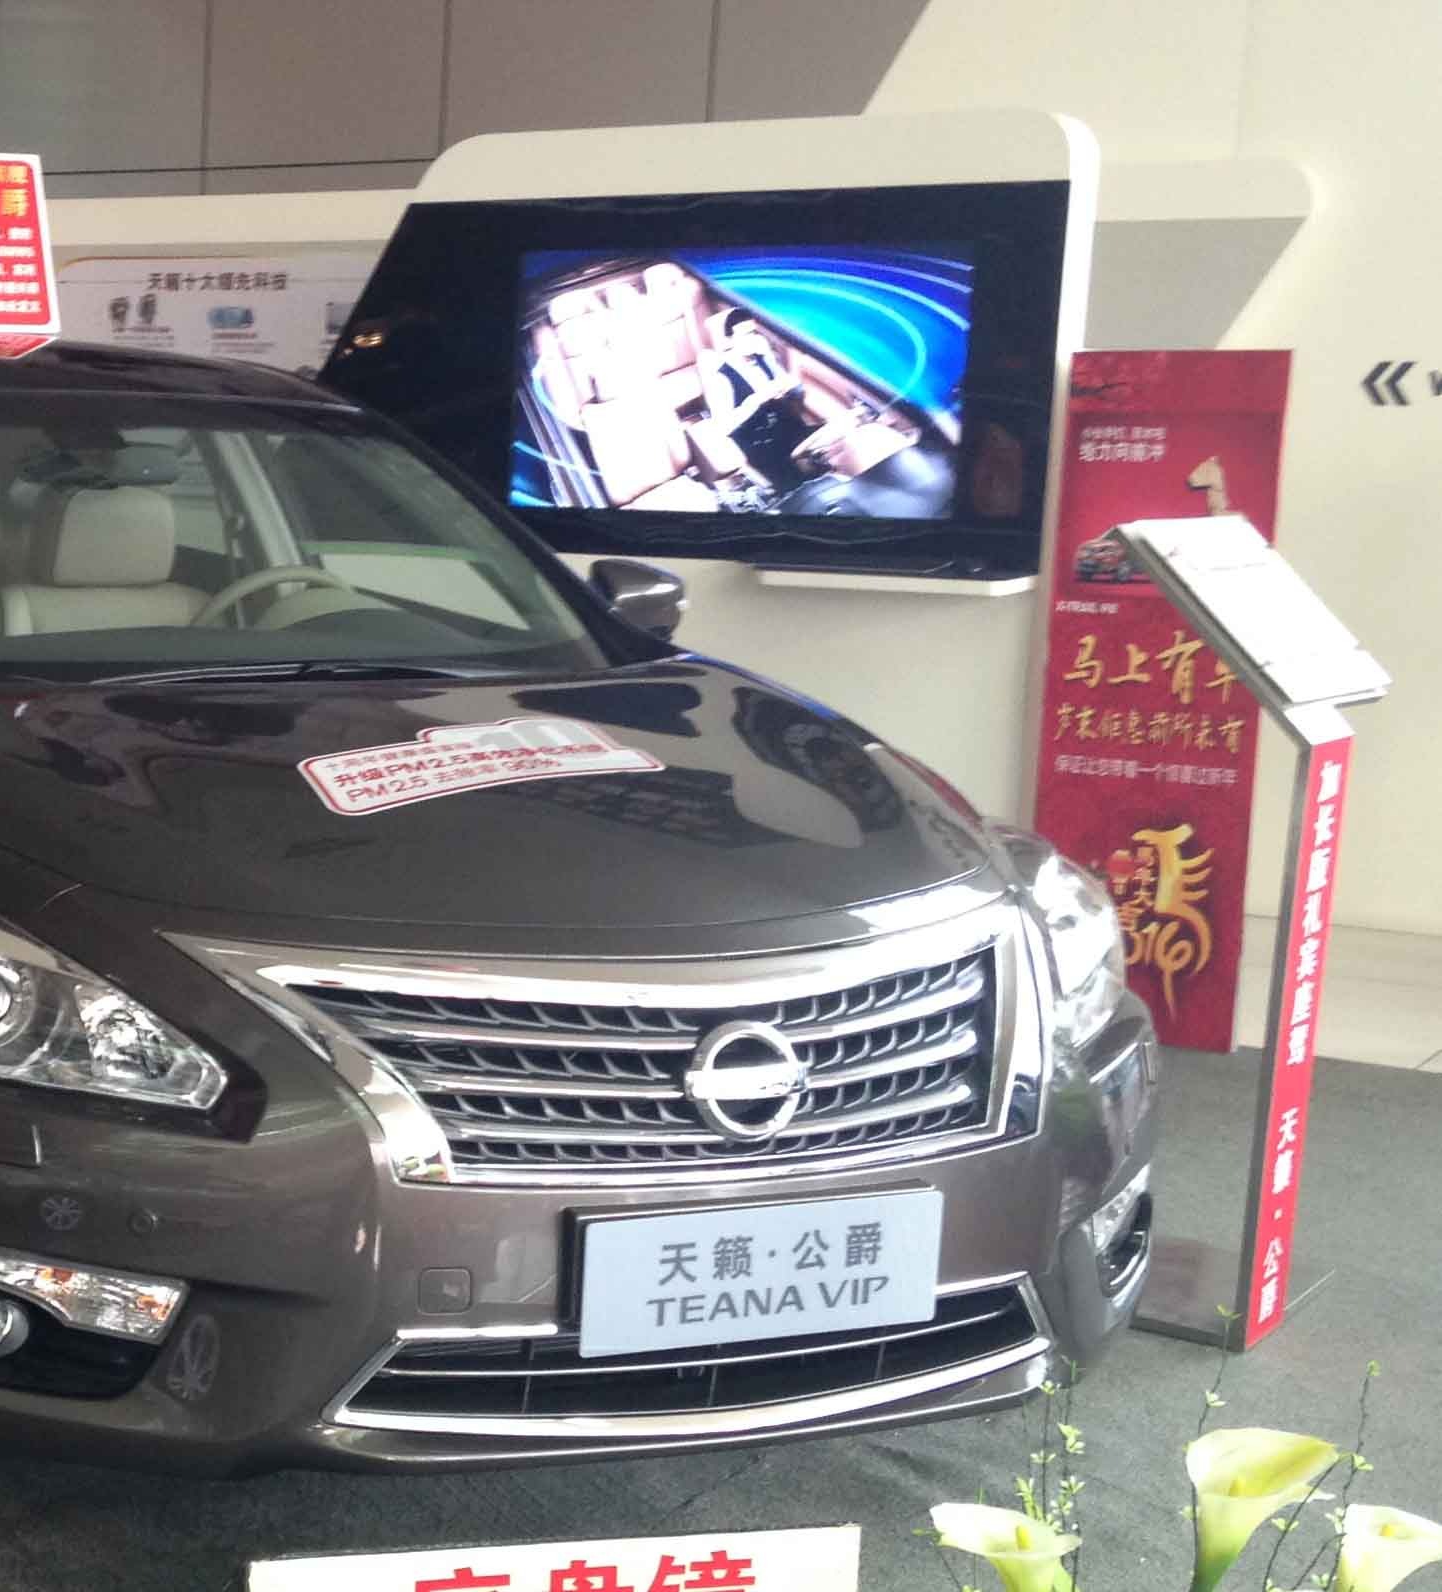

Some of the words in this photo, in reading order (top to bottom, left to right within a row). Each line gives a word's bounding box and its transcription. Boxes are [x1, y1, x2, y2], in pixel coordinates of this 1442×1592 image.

[659, 1222, 884, 1287] 天籁·公爵
[646, 1284, 805, 1328] TEANA
[817, 1275, 890, 1310] VIP
